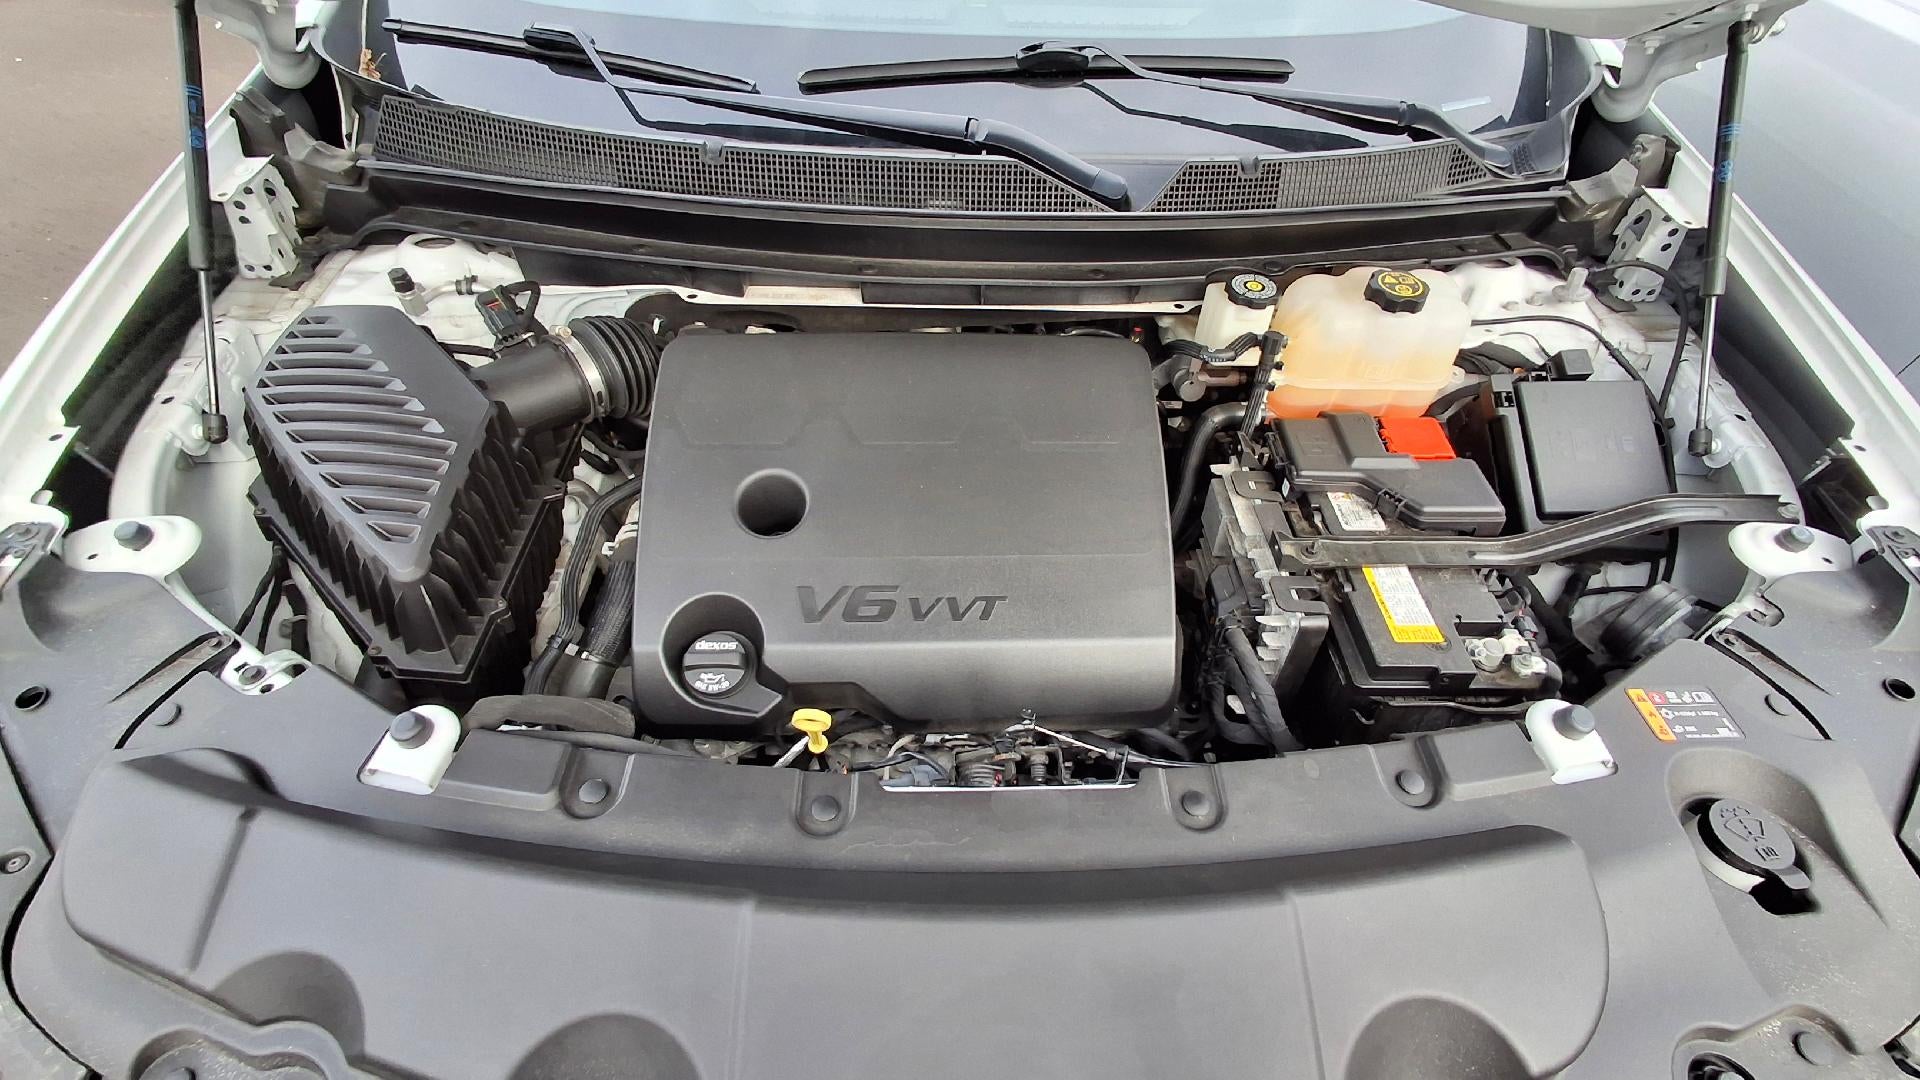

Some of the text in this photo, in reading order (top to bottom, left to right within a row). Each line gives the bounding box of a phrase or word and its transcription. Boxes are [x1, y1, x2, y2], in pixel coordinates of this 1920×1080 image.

[796, 584, 1009, 624] V6 VVT
[695, 640, 739, 650] dexos
